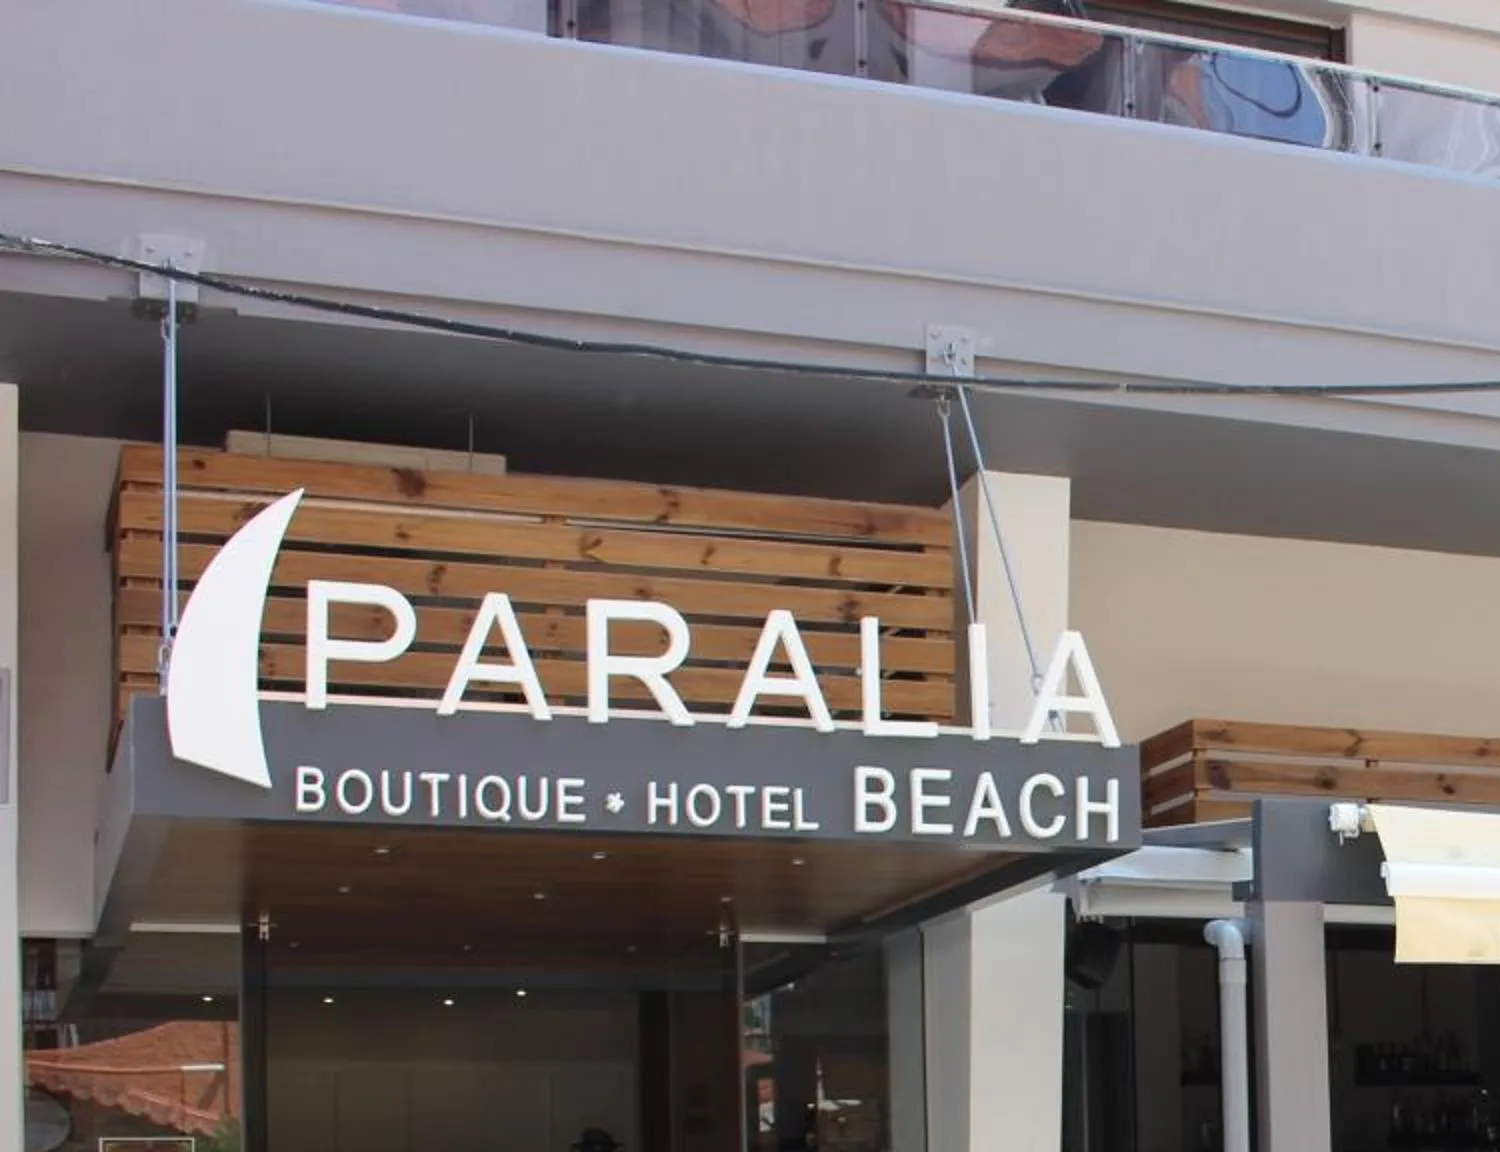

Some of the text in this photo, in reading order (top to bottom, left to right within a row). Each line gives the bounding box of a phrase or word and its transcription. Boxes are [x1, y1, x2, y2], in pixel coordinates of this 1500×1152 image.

[305, 579, 1121, 748] PARALIA
[295, 764, 1120, 843] BOUTIQUE HOTEL BEACH
